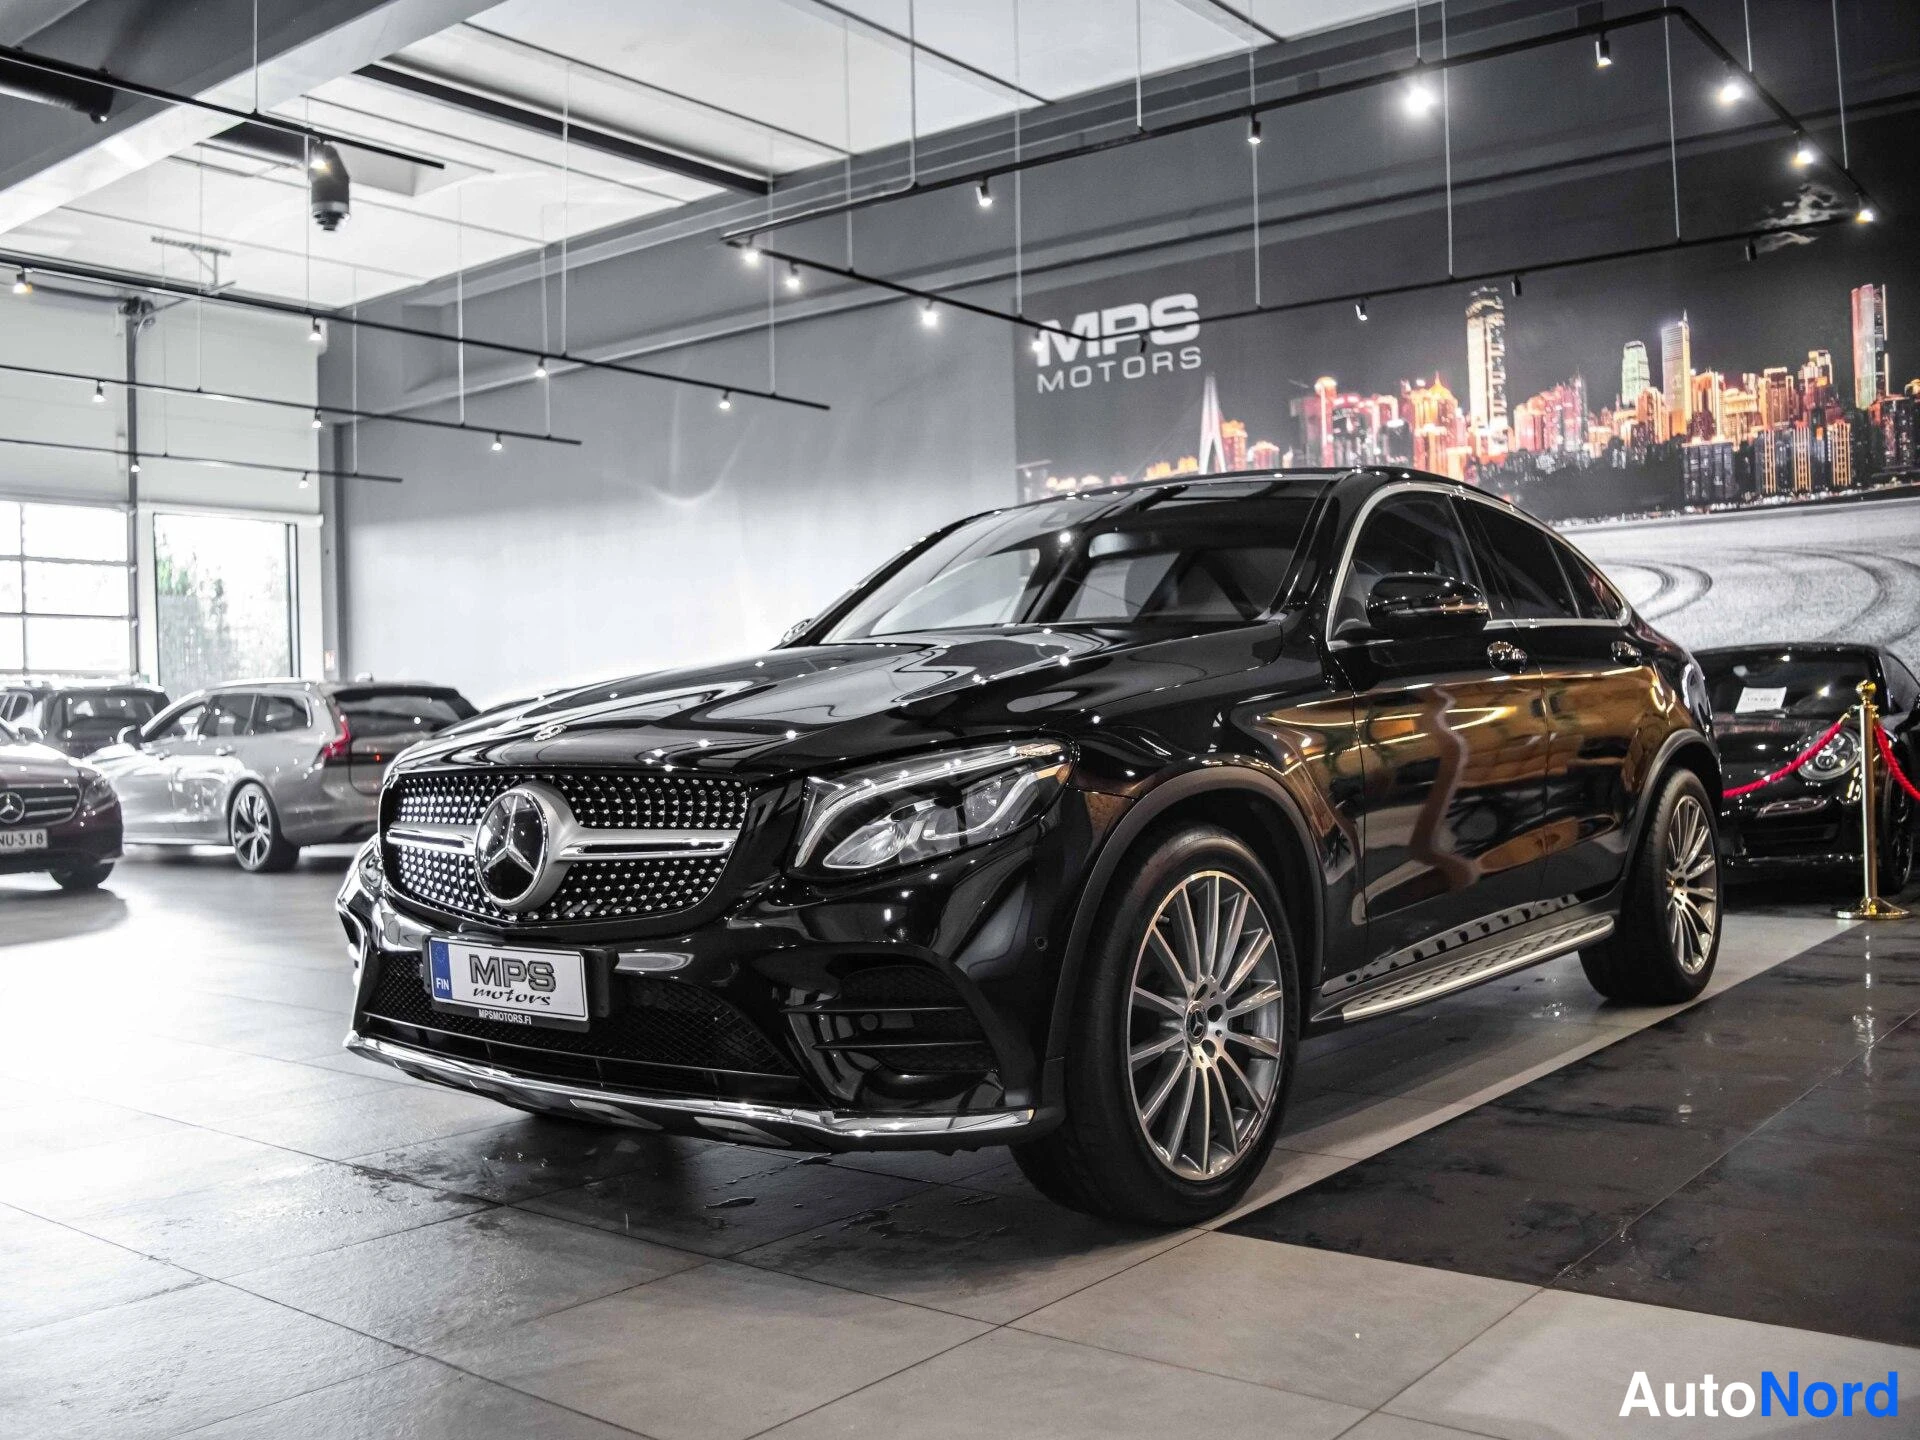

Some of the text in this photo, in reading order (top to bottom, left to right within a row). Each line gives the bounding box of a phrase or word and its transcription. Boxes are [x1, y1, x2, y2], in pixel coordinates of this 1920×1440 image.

[1037, 293, 1200, 367] MPS
[1037, 347, 1201, 394] MOTORS
[436, 977, 449, 990] FIN
[469, 954, 556, 992] MPS
[473, 988, 550, 1005] motors
[478, 1009, 532, 1025] MPSMOTORS.FI
